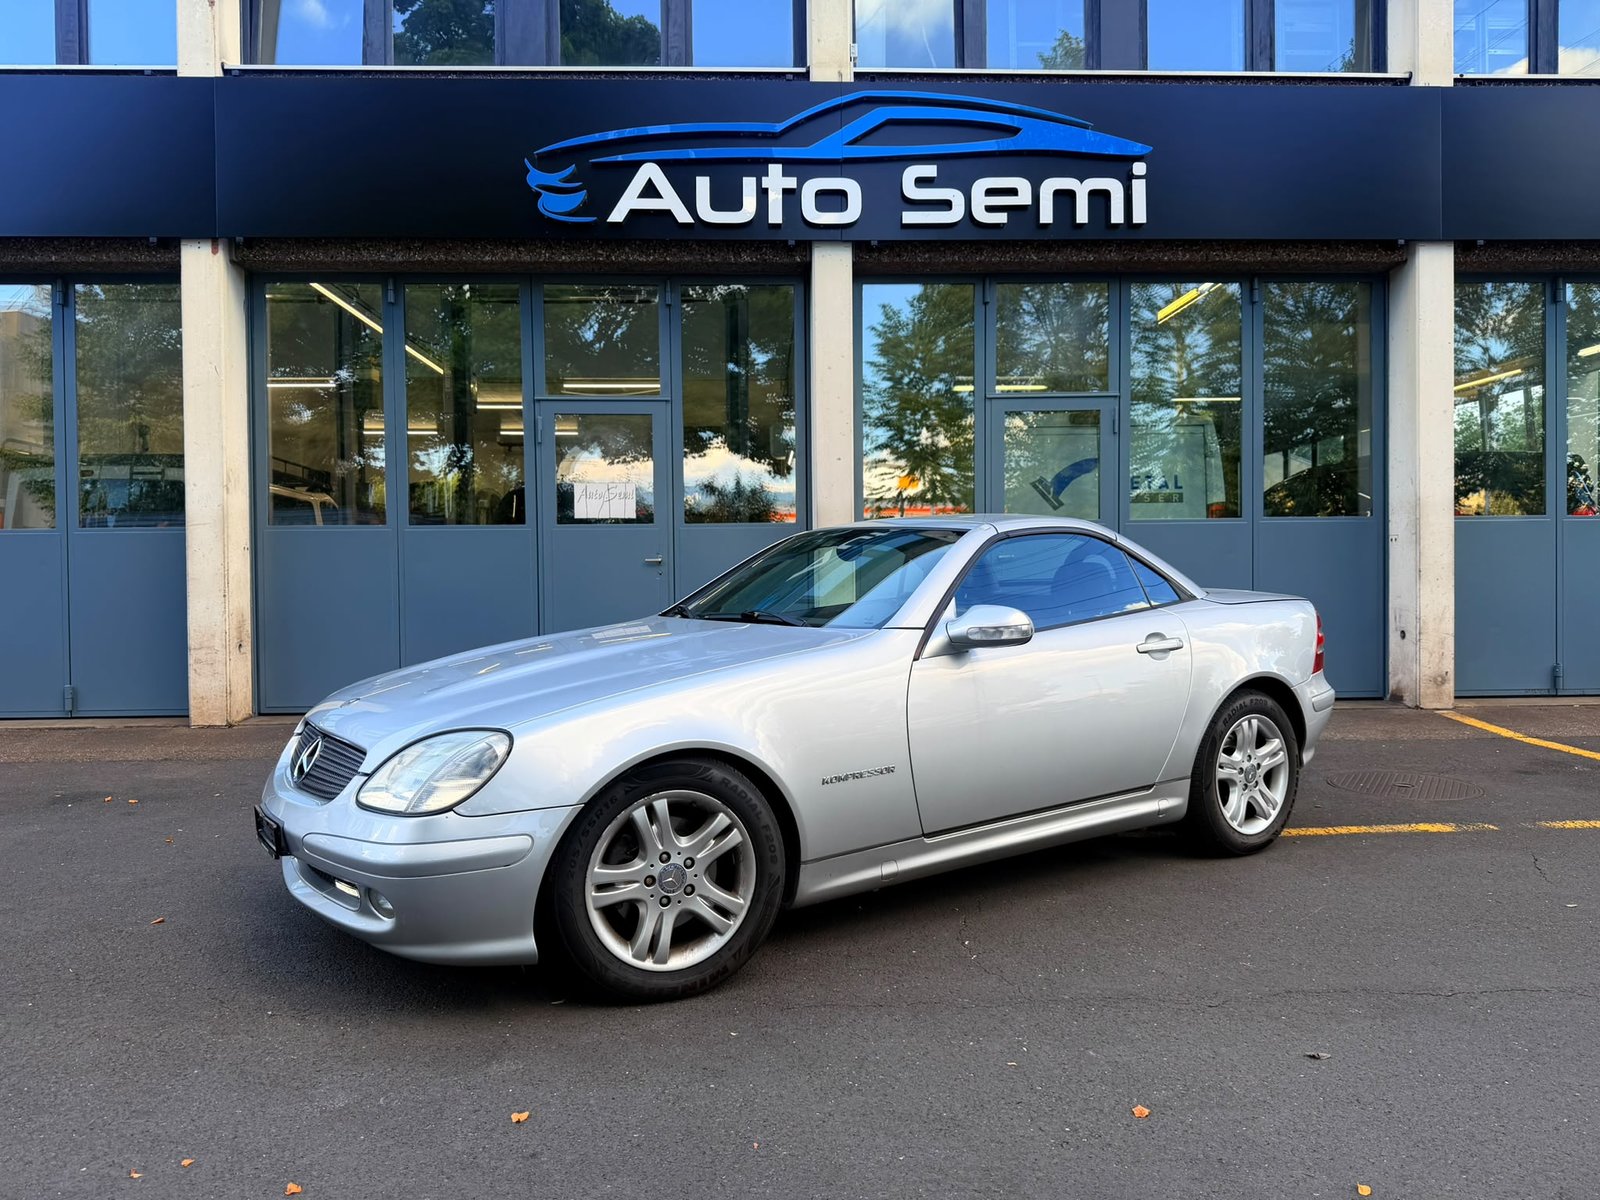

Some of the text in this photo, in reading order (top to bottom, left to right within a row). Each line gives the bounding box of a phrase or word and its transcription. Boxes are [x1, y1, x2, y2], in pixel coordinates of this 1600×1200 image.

[606, 161, 1147, 225] Auto Semi
[821, 764, 896, 786] KOMPRESSOR
[720, 777, 763, 821] RADIAL
